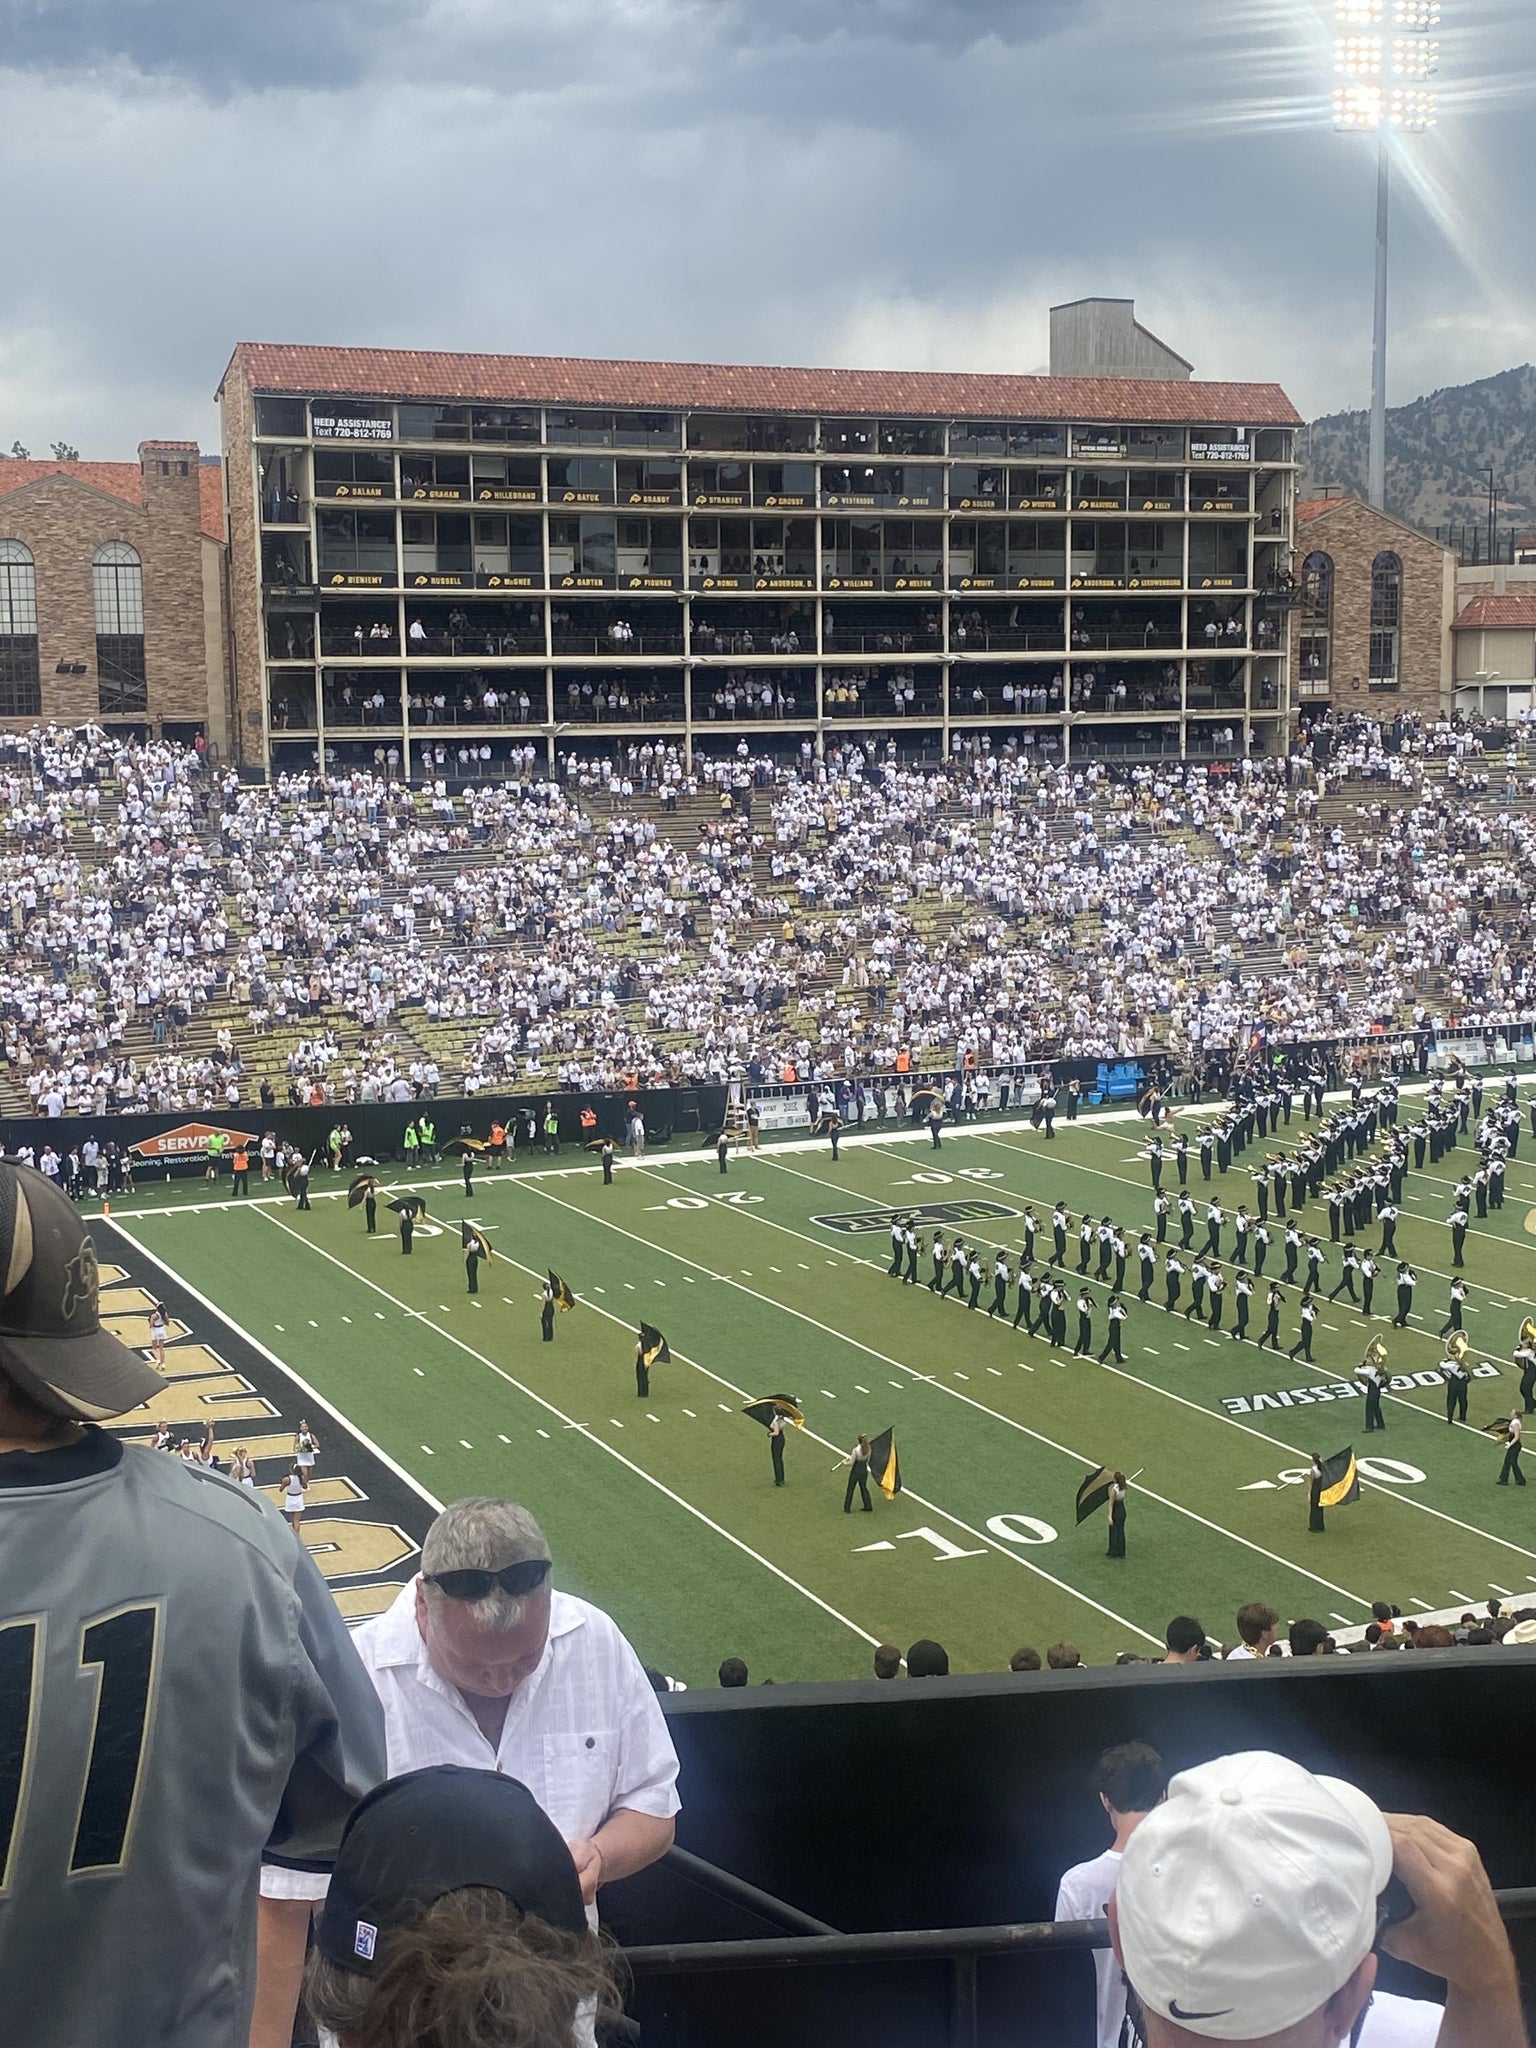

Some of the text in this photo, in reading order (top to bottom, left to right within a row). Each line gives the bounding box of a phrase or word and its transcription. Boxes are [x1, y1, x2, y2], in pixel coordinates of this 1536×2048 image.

[314, 417, 391, 429] NEED ASSISTANCE?
[314, 426, 392, 439] Text 720-812-1769
[428, 490, 460, 500] GRAHAM
[430, 577, 462, 585] RUSSELL
[157, 1133, 230, 1151] SERVPO
[164, 1155, 210, 1165] Restoration
[1222, 1361, 1501, 1414] POGESSIVE
[895, 1513, 1059, 1562] 10
